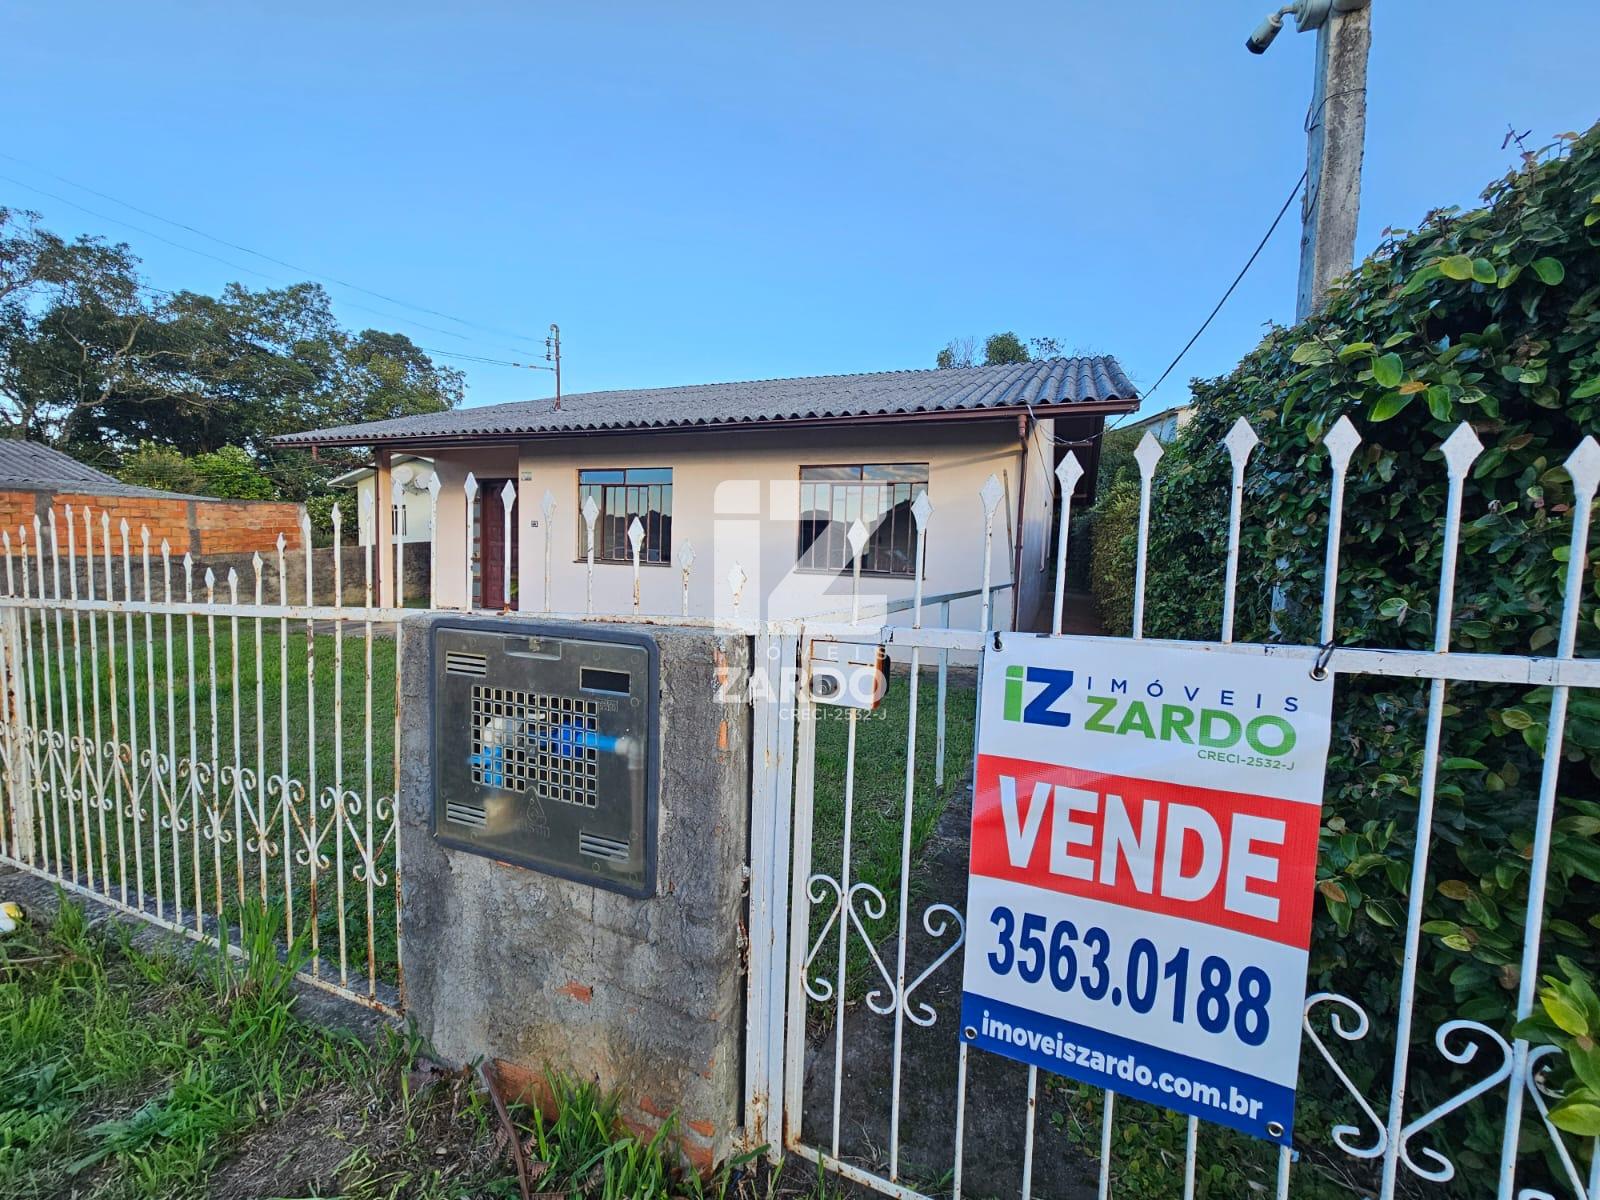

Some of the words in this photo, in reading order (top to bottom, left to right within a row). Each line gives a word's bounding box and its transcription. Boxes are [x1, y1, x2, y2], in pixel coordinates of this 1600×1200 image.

[1084, 696, 1297, 756] ZARDO
[1087, 676, 1298, 712] IMÓVEIS
[1197, 749, 1296, 771] CRECI-2532-J
[999, 775, 1287, 923] VENDE
[987, 906, 1272, 1047] 3563.0188
[981, 1010, 1264, 1120] imoveiszardo.com.br
